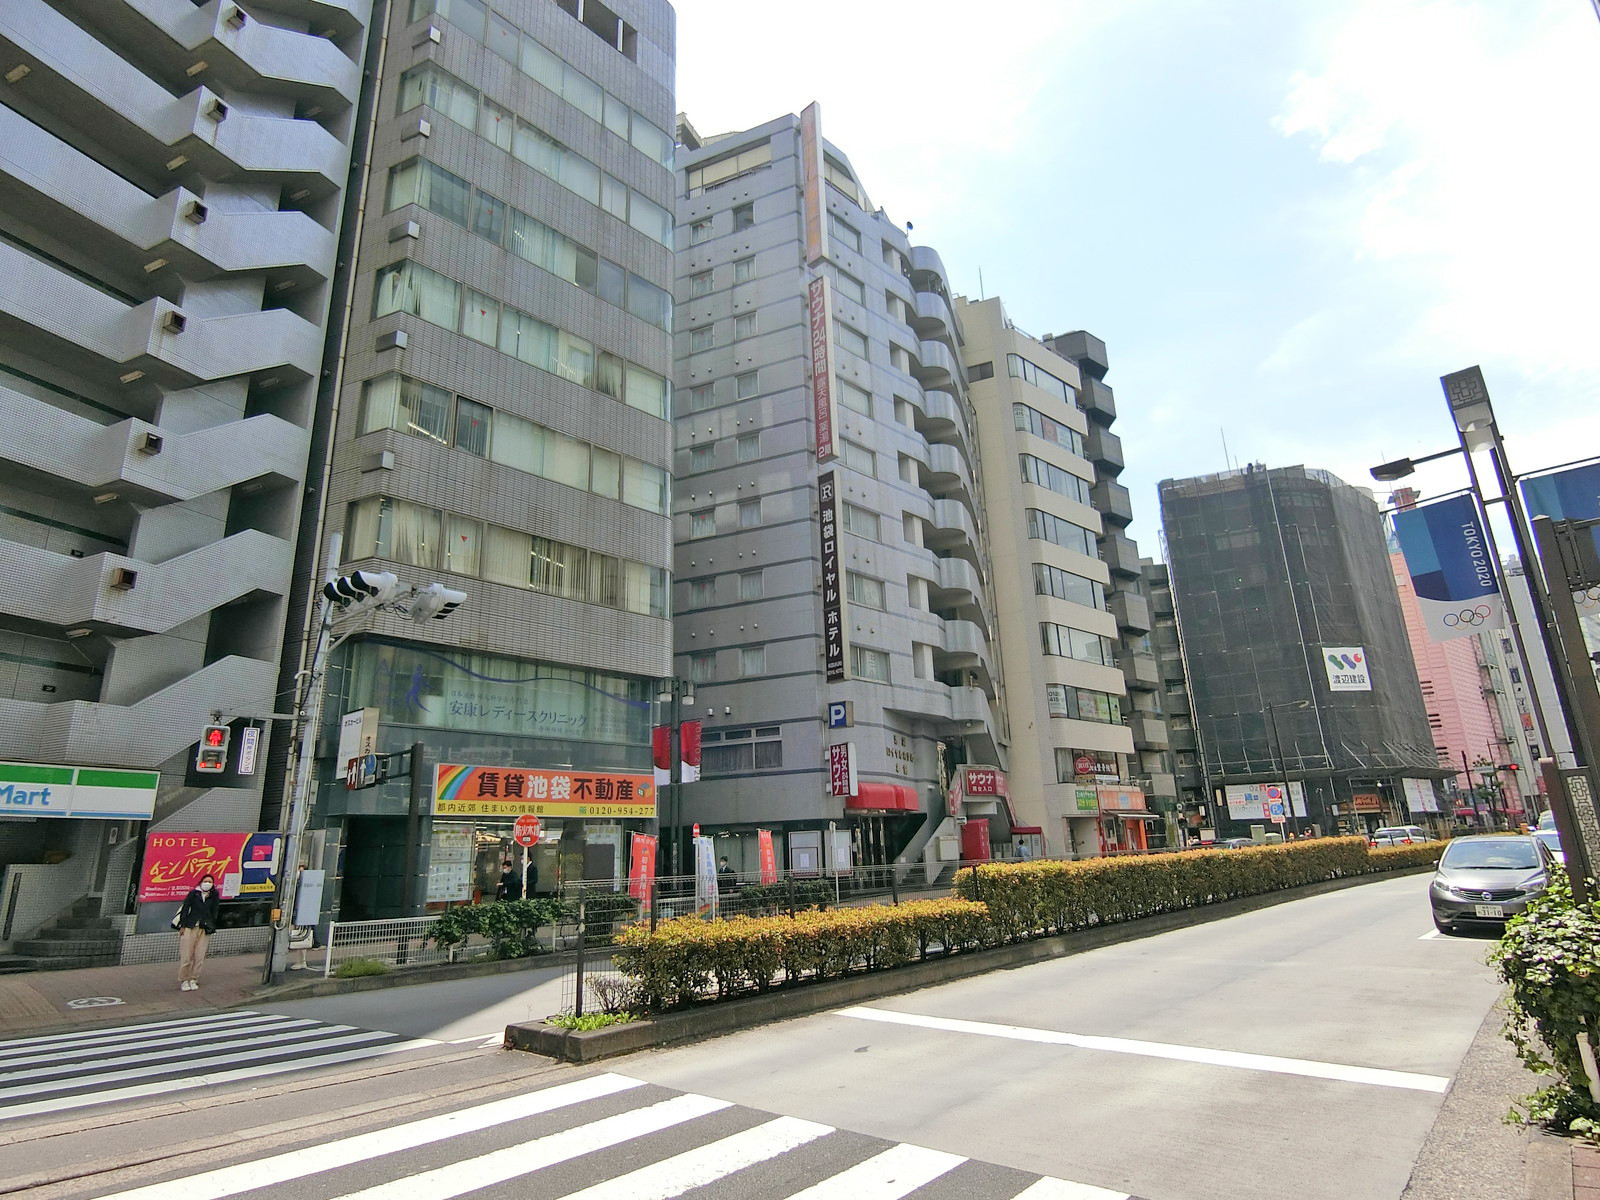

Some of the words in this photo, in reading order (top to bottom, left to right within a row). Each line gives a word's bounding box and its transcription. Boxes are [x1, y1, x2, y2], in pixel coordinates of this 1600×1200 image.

[811, 280, 826, 374] サウナ24時間
[818, 444, 831, 458] 2階
[822, 484, 832, 500] R
[1461, 521, 1483, 558] TOKYO
[1473, 560, 1492, 587] 2020
[822, 508, 840, 657] 池袋ロイヤルホテル
[449, 700, 587, 728] 安康レディースクリニック
[831, 705, 845, 726] P
[832, 746, 842, 794] サウナ
[840, 745, 849, 793] 男女24時間
[968, 773, 994, 785] サウナ
[0, 785, 51, 805] Mart
[477, 771, 634, 800] 賃貸池袋不動産
[437, 802, 477, 813] 都内近郊
[481, 804, 545, 814] 住まいの情報館
[589, 806, 655, 815] 0120-954-277
[152, 837, 209, 847] HOTEL
